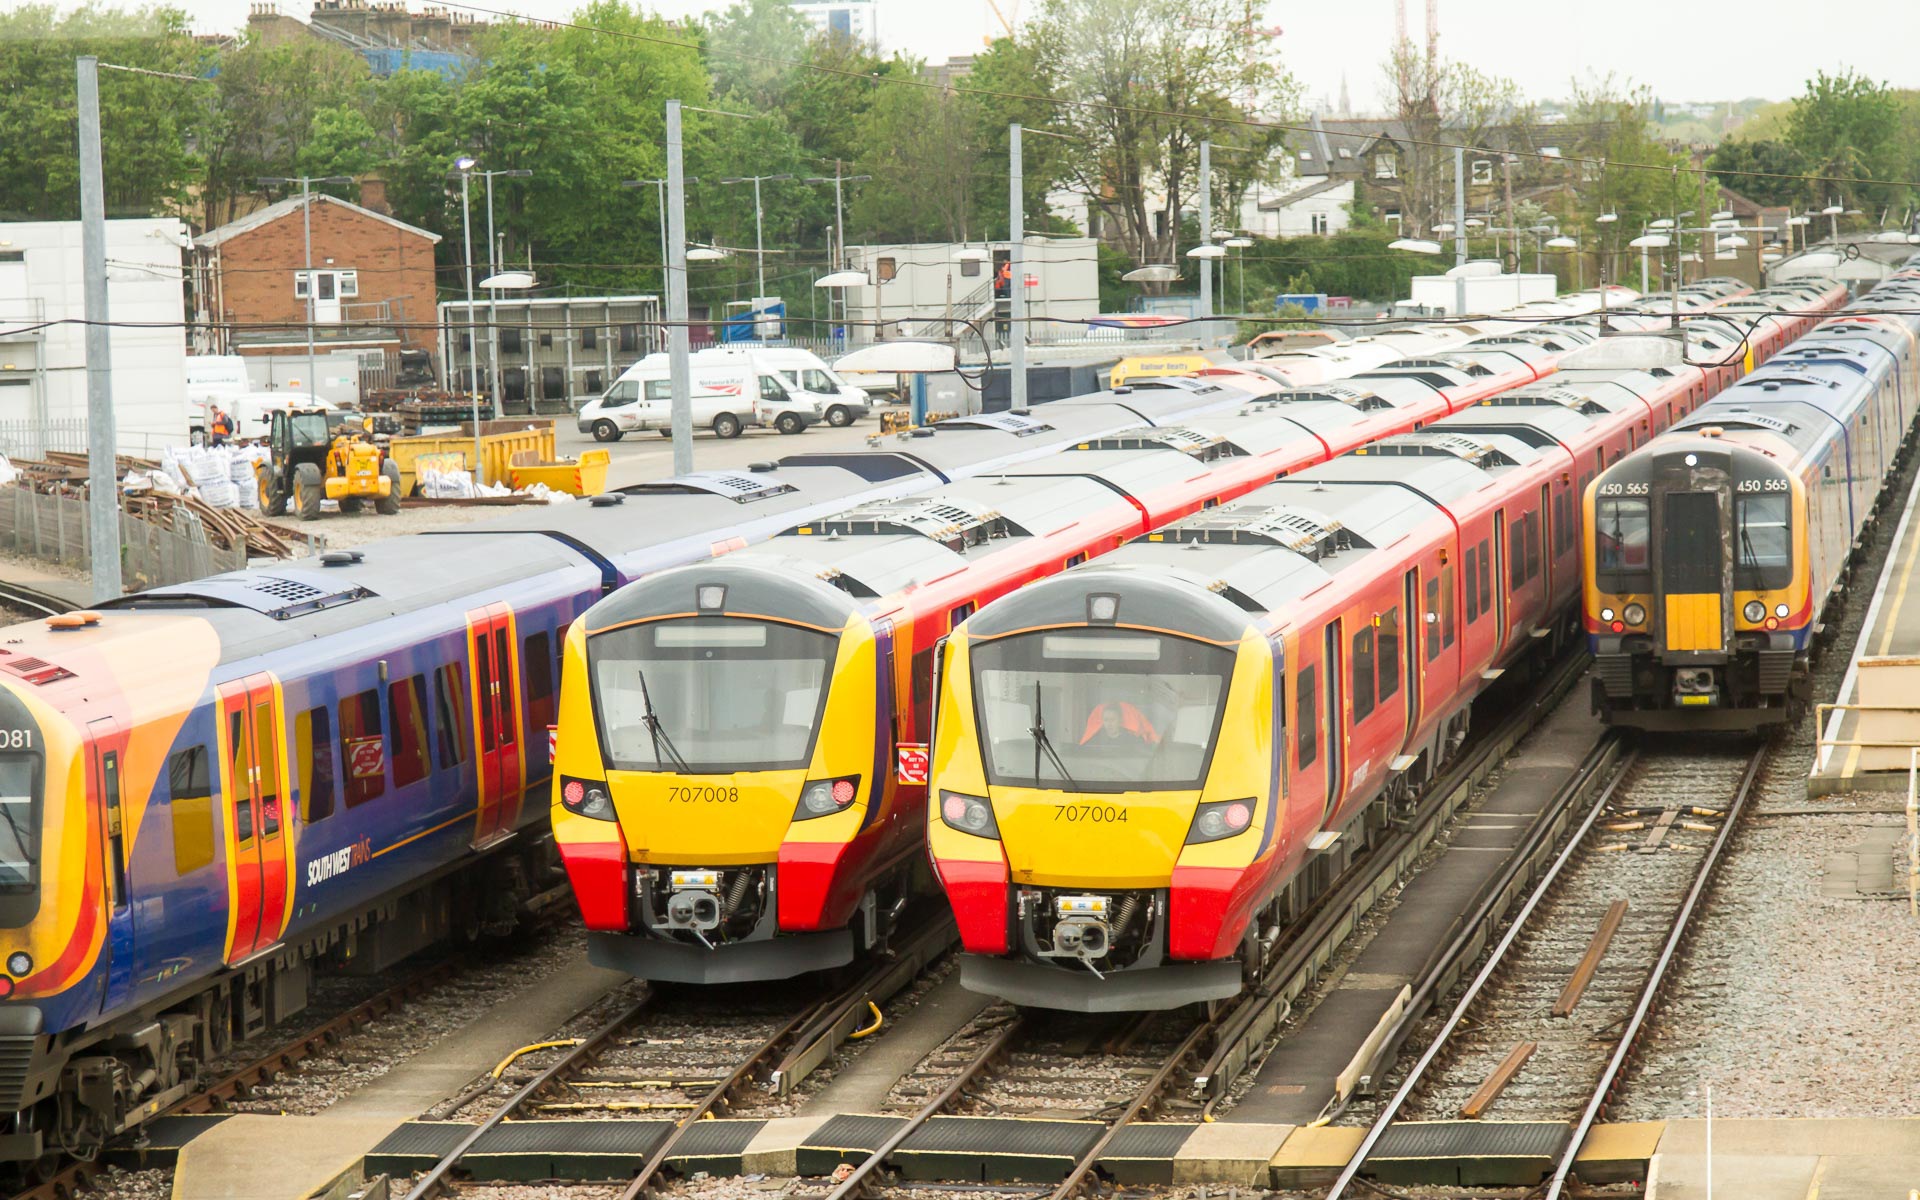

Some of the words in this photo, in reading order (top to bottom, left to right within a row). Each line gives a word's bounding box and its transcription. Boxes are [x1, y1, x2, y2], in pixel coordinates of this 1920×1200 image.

[1600, 484, 1623, 495] 450
[1625, 483, 1649, 495] 565
[1737, 480, 1761, 492] 450
[1764, 480, 1788, 491] 565
[0, 729, 31, 749] 081
[668, 787, 739, 803] 707008
[1054, 805, 1129, 823] 707004
